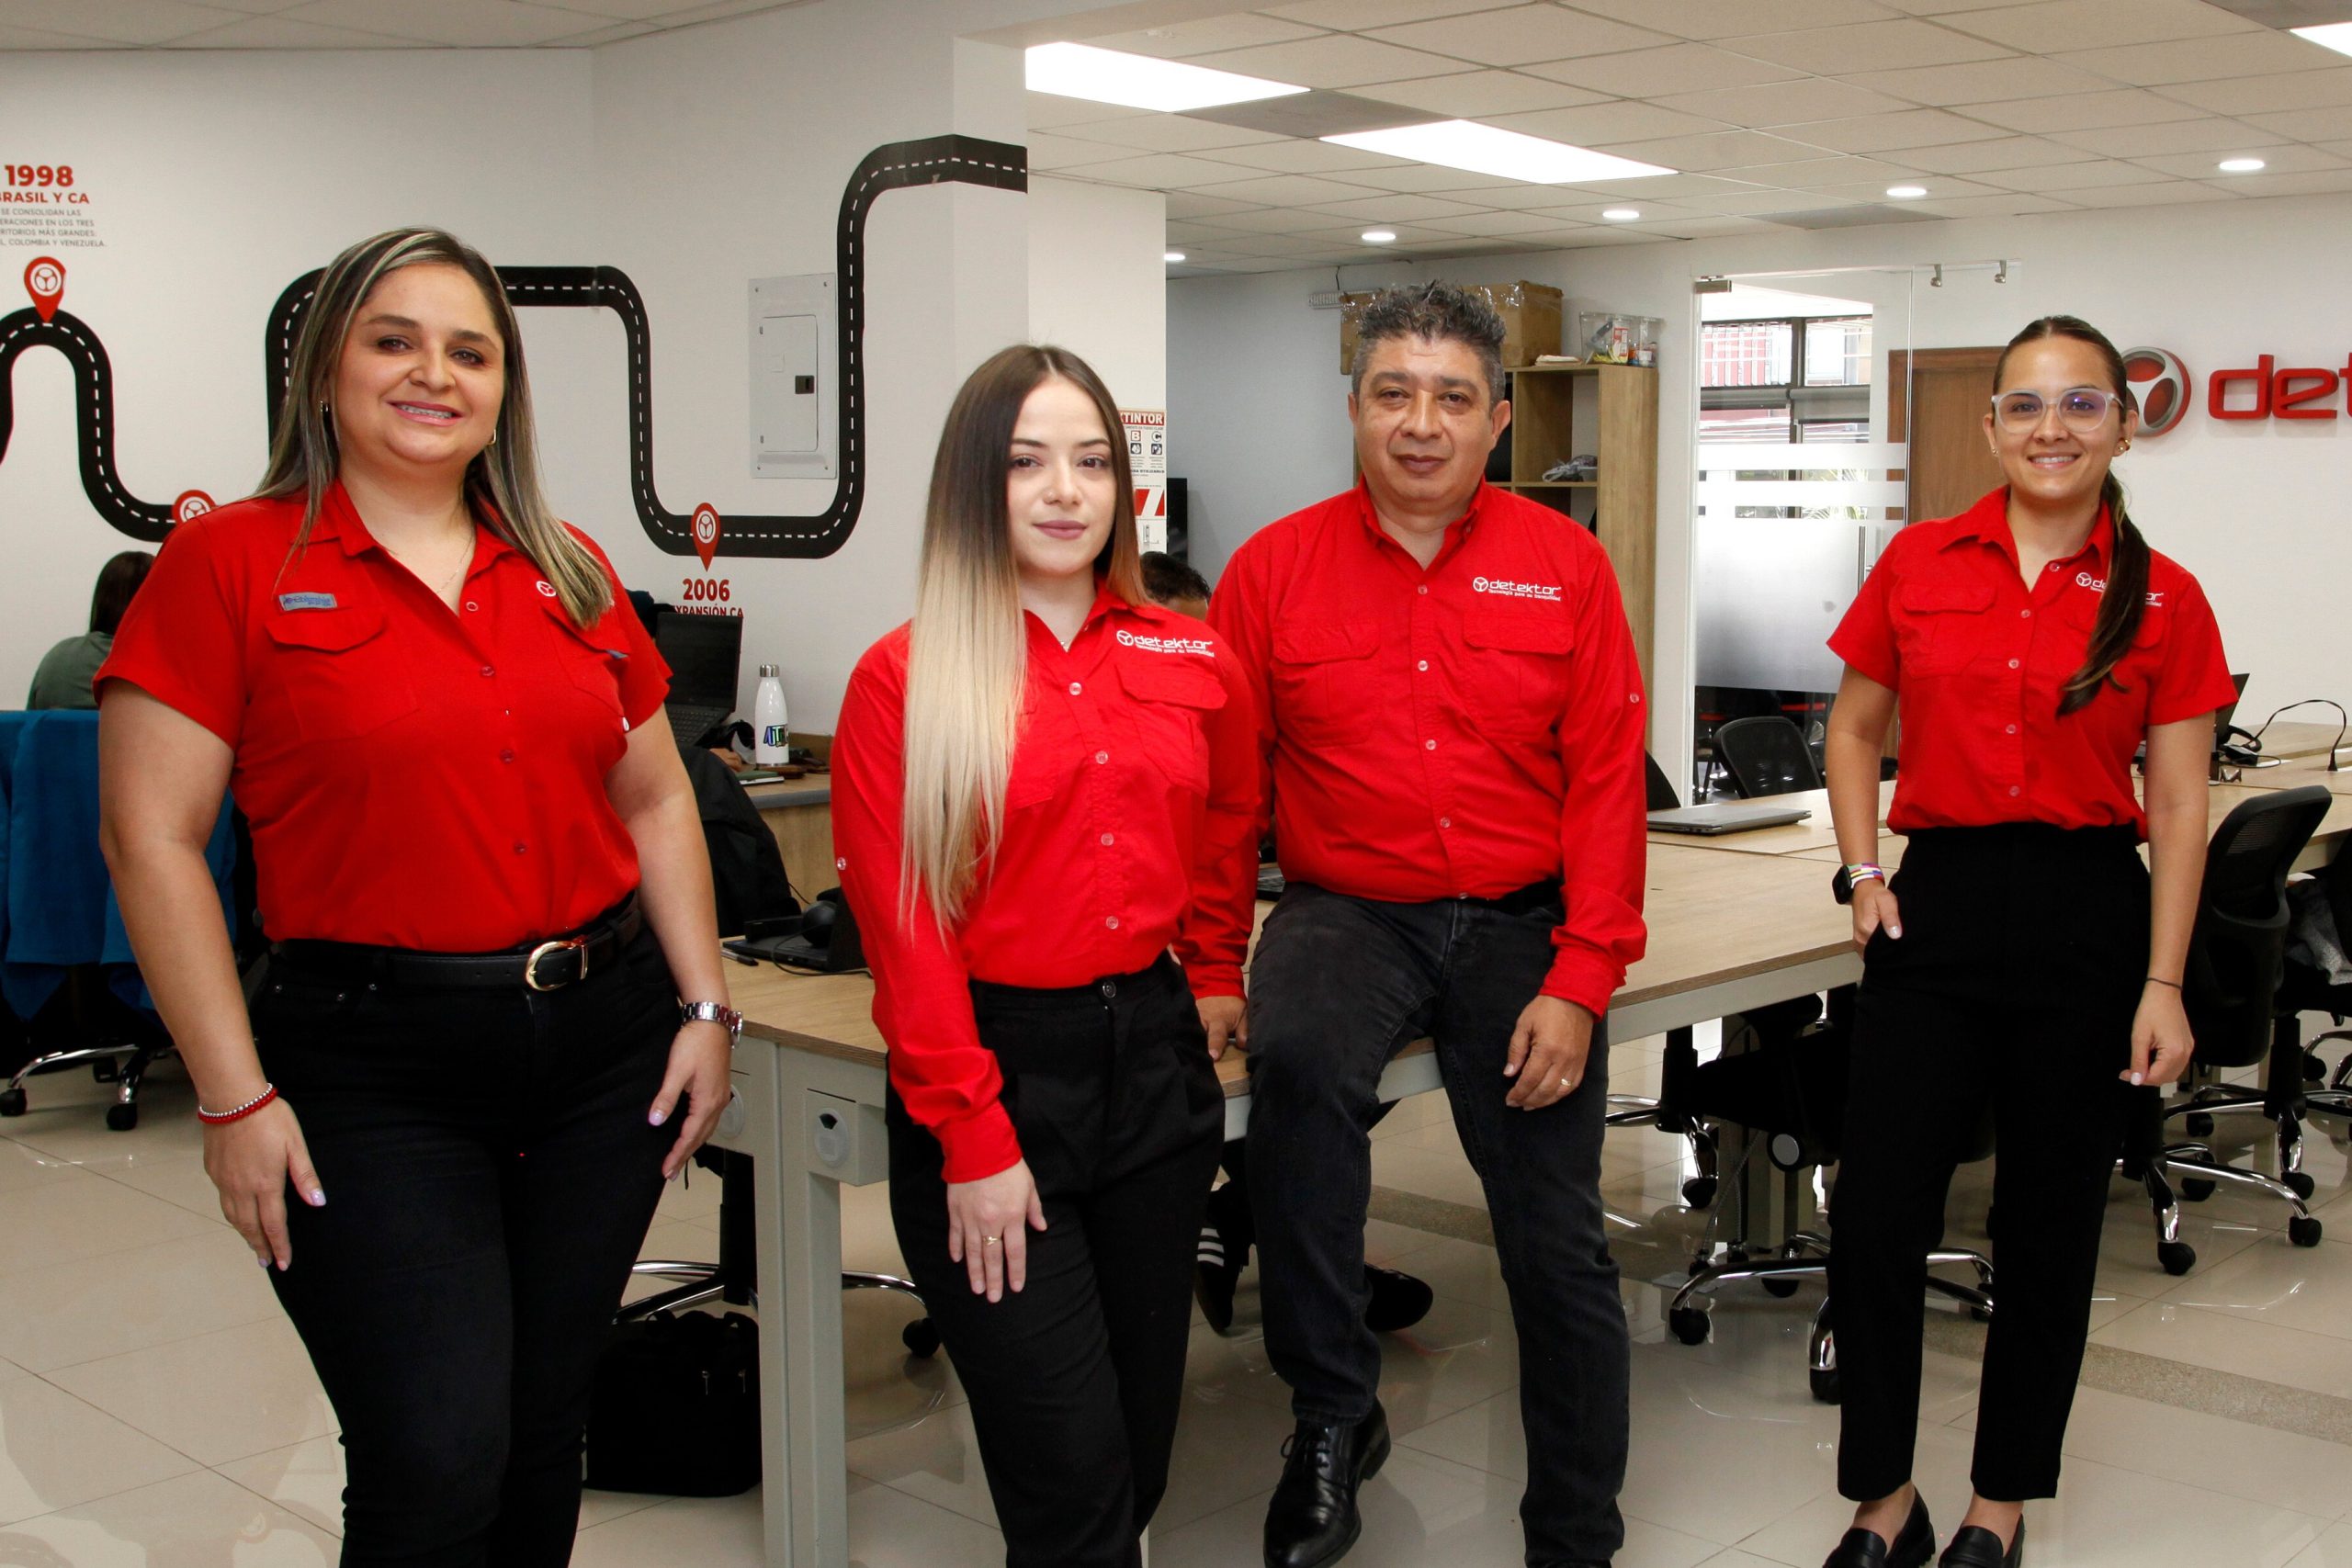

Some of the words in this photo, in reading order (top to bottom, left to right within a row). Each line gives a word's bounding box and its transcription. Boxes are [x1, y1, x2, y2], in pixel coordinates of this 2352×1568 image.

[5, 164, 74, 187] 1998
[0, 191, 48, 203] RASIL
[52, 192, 62, 203] Y
[68, 192, 90, 204] CA
[13, 208, 64, 216] CONSOLIDAN
[66, 209, 81, 217] LAS
[46, 219, 56, 227] EN
[58, 219, 74, 227] LOS
[76, 219, 95, 228] TRES
[8, 238, 50, 247] COLOMBIA
[1131, 431, 1141, 442] B
[1151, 431, 1162, 443] C
[683, 578, 730, 602] 2006
[1489, 579, 1561, 595] detektor
[674, 604, 727, 616] XPANSIÓN
[1134, 635, 1213, 650] detektor
